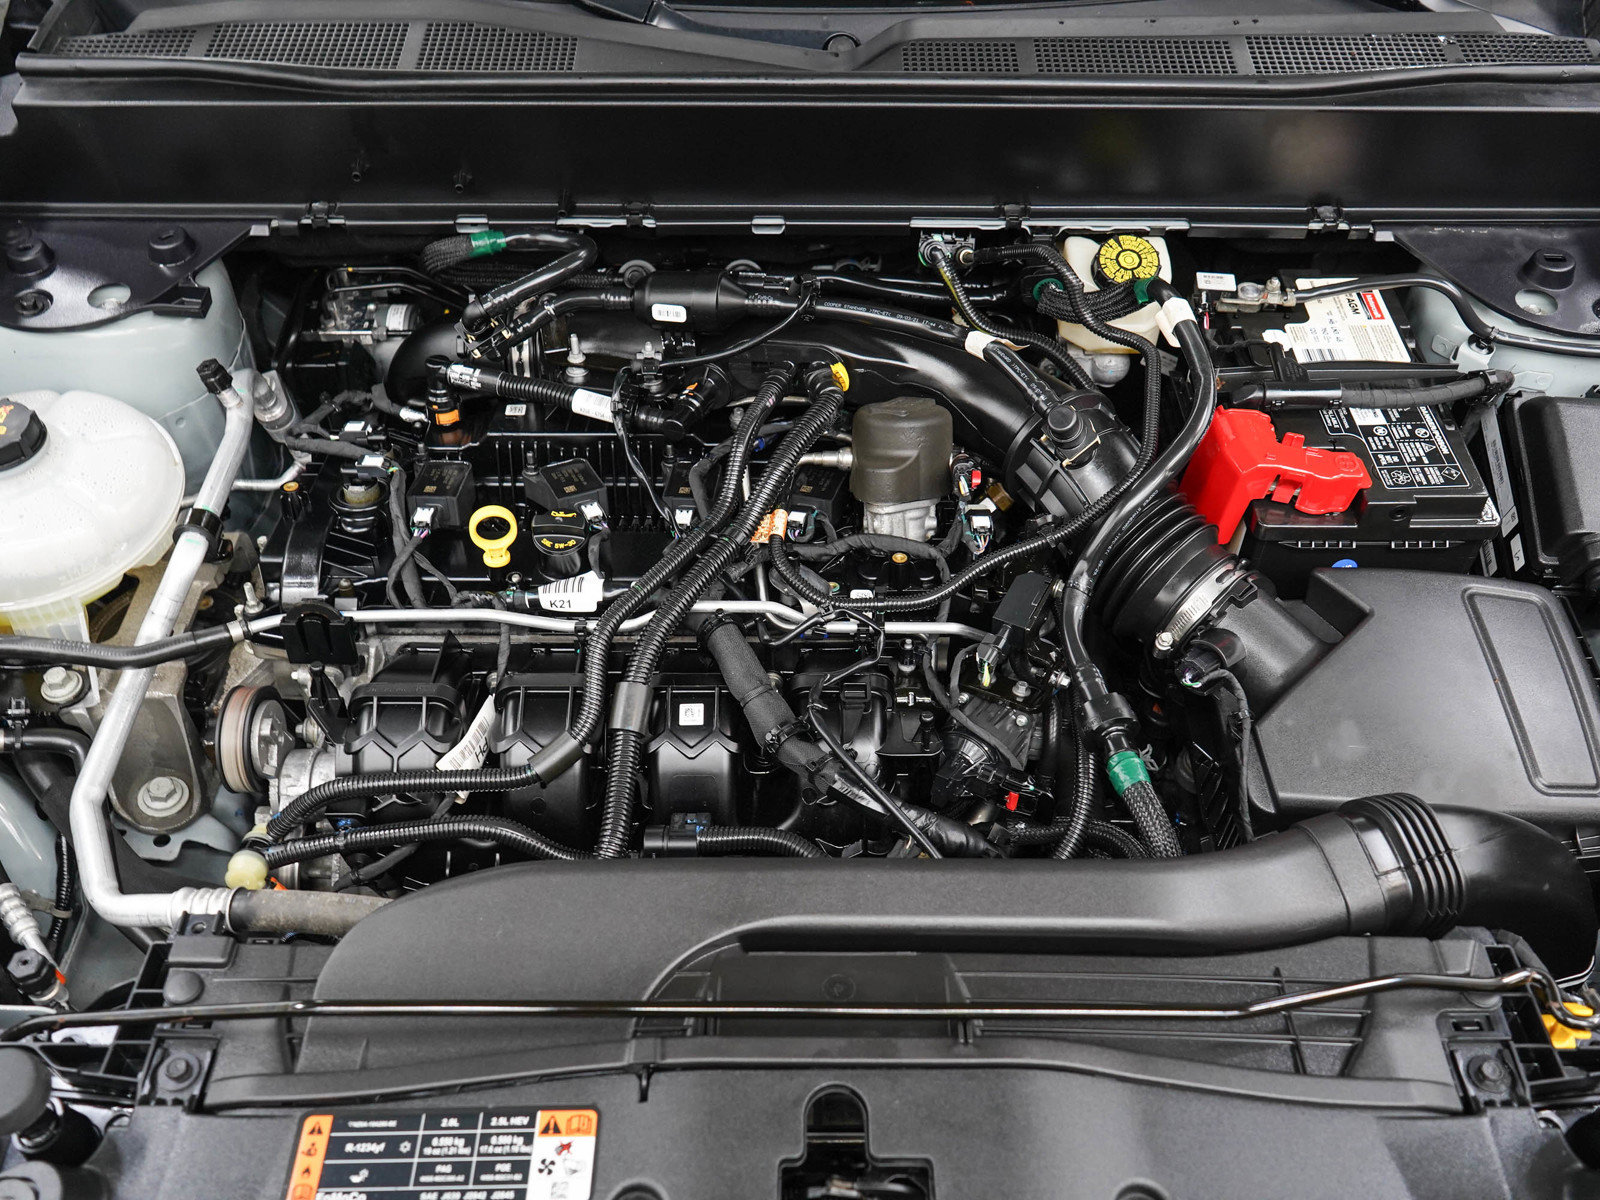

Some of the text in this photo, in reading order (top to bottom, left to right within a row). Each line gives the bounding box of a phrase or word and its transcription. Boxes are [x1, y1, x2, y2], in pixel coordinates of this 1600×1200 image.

[843, 304, 867, 312] STANDARD
[1346, 297, 1360, 315] AGM
[541, 538, 553, 548] SAE
[549, 599, 572, 609] K21
[509, 1116, 530, 1126] HEV
